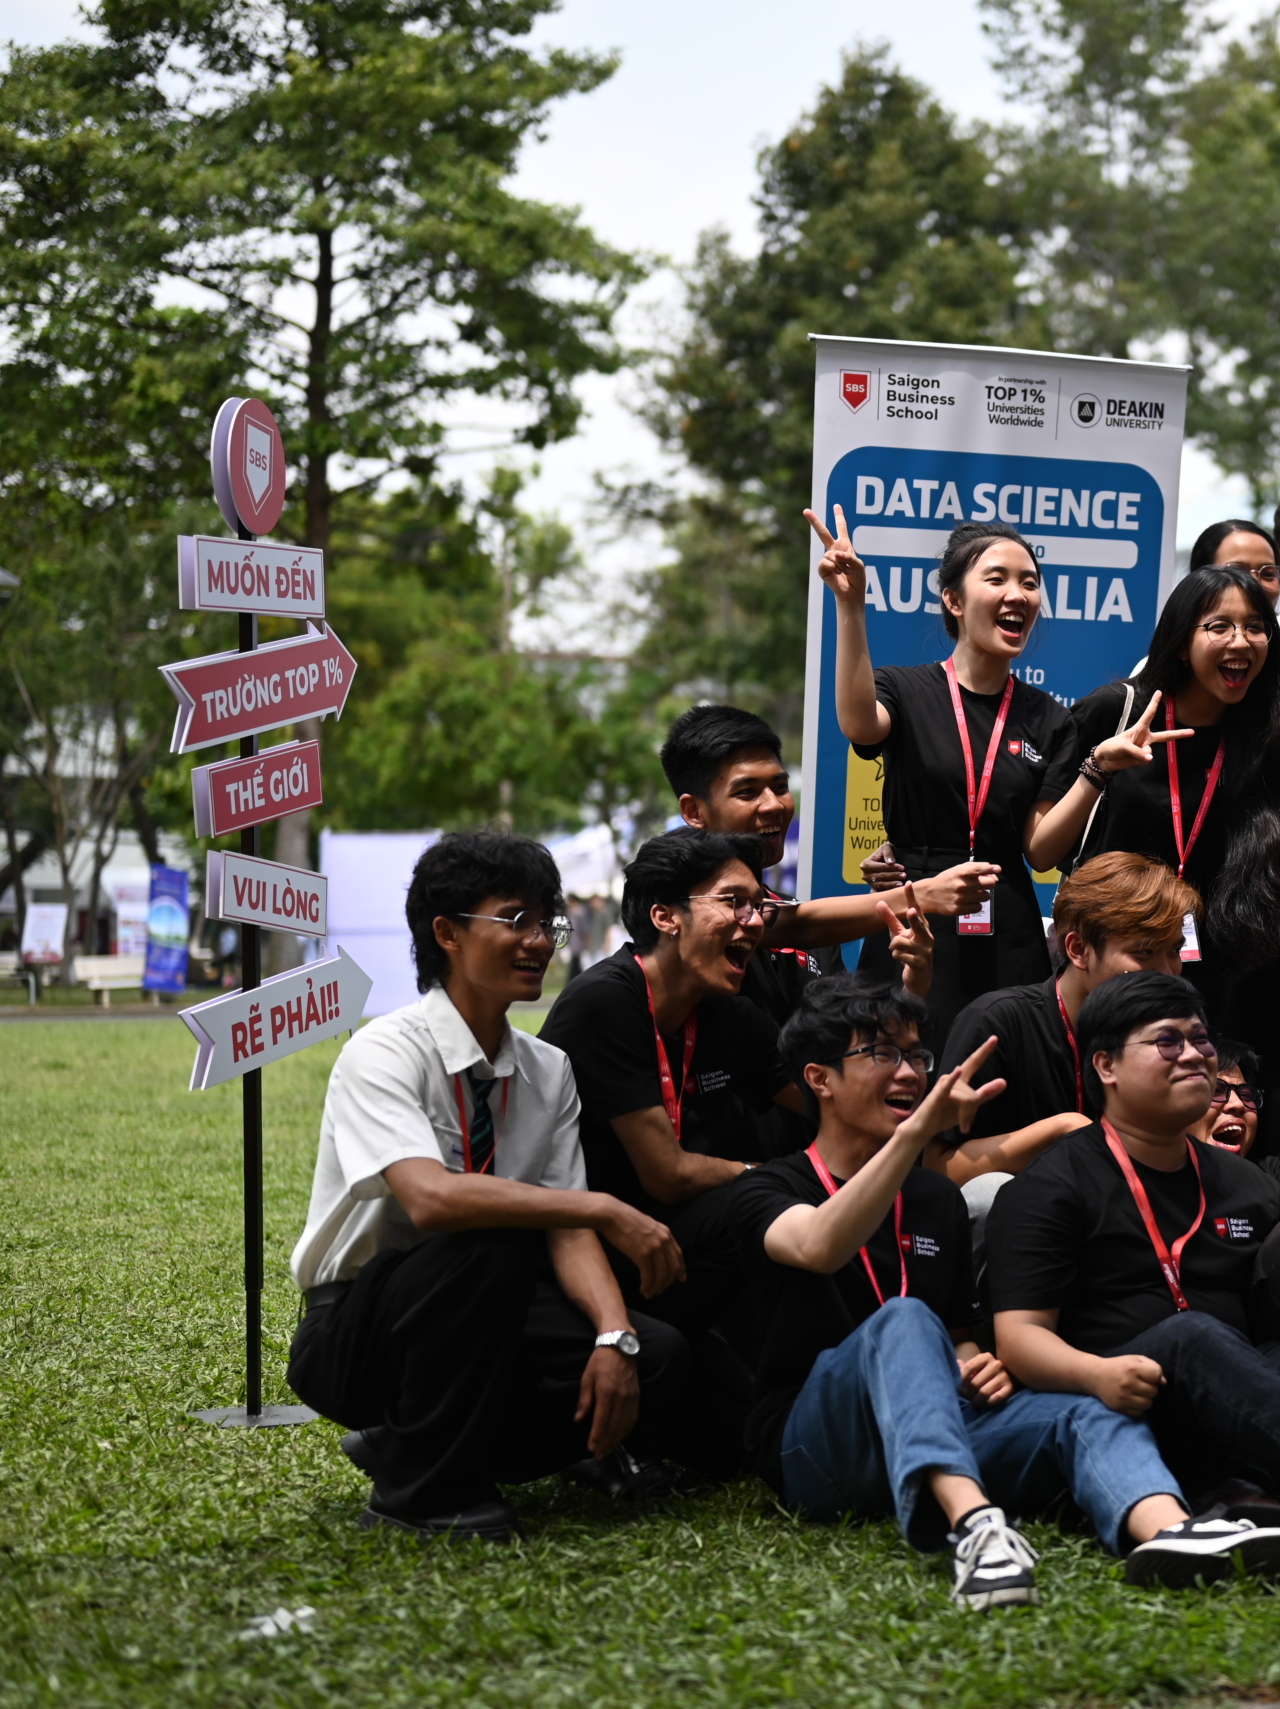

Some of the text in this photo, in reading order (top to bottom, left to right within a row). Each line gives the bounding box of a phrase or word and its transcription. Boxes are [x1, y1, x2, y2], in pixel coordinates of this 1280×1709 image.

[845, 384, 865, 393] SBS
[888, 374, 940, 390] Saigon
[887, 390, 955, 406] Business
[985, 386, 1045, 403] TOP 1%
[887, 406, 938, 420] School
[987, 402, 1044, 416] Universities
[1106, 399, 1164, 419] DEAKIN
[988, 414, 1044, 427] Worldwide
[1106, 417, 1163, 430] UNIVERSITY
[249, 448, 267, 472] SBS
[856, 475, 1141, 530] DATA SCIENCE
[207, 551, 315, 601] MUỐN ĐẾN
[1025, 666, 1045, 685] to
[201, 656, 343, 723] TRƯỜNG TOP 1%
[226, 756, 309, 815] THẾ GIỚI
[232, 875, 266, 912] VUI
[272, 878, 319, 923] LÒNG
[232, 1003, 265, 1063] RẼ
[700, 1070, 724, 1080] Saigon
[702, 1074, 731, 1086] Business
[704, 1081, 726, 1092] School
